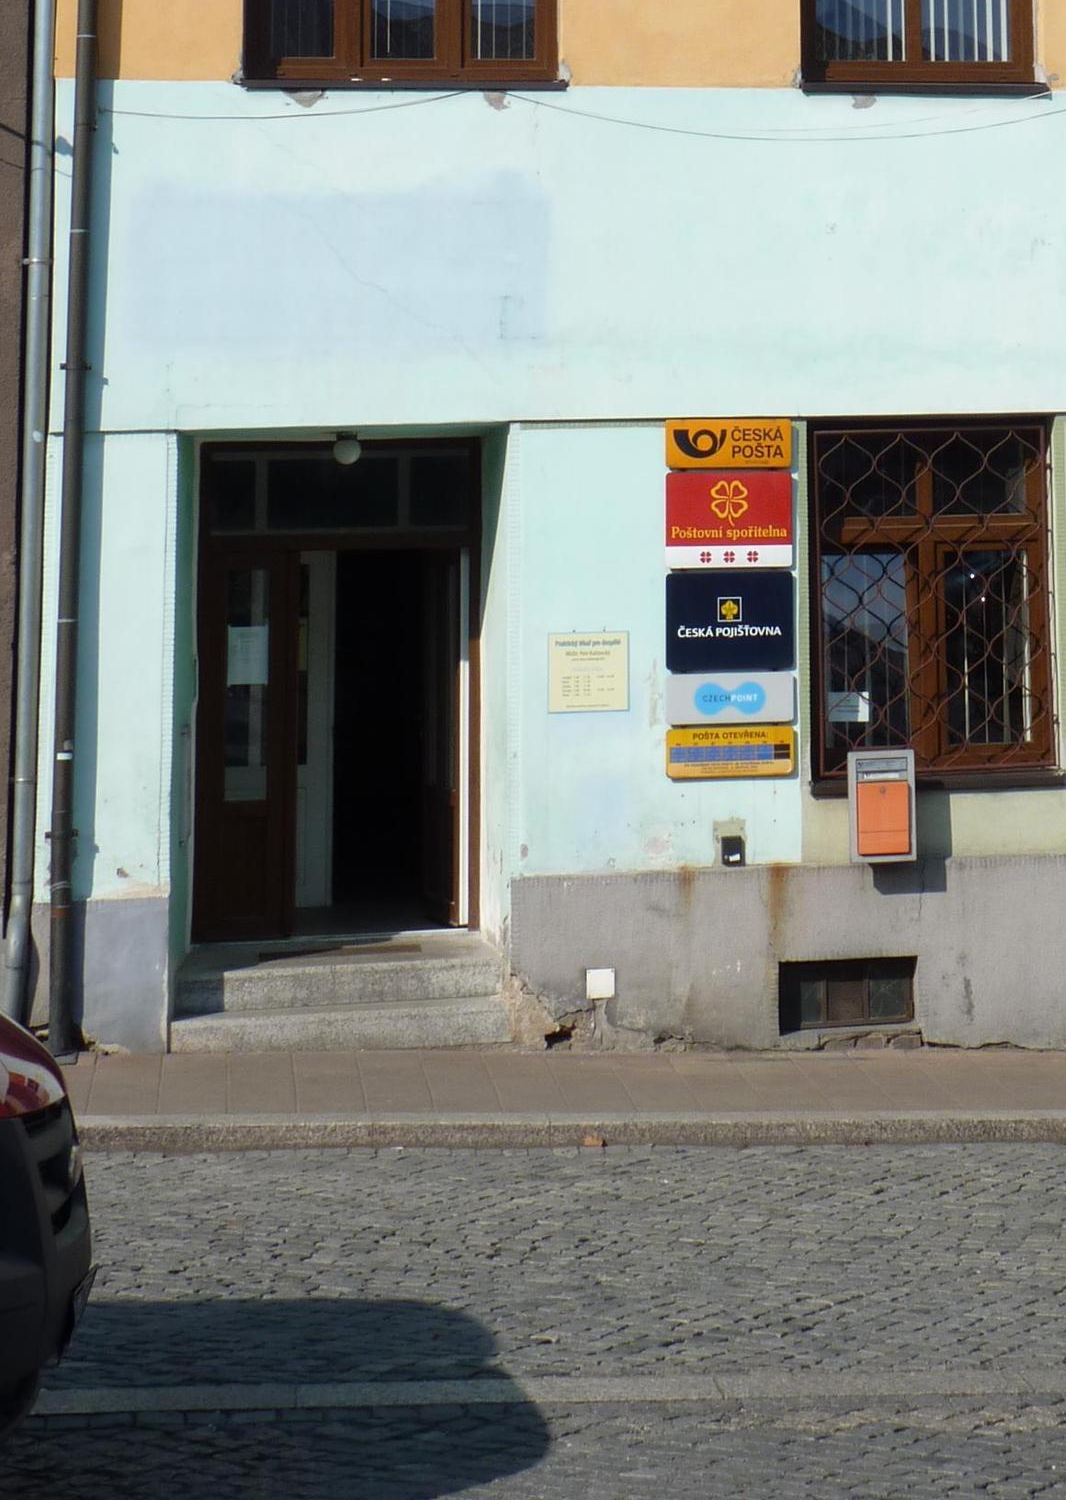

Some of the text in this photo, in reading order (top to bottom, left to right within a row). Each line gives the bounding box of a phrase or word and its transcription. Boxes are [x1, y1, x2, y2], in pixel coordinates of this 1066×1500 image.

[731, 426, 784, 441] ČESKÁ
[731, 443, 784, 458] POŠTA
[671, 525, 787, 540] Poštovní spořitelna
[677, 625, 782, 638] ČESKÁ POJIŠŤOVNA
[692, 731, 720, 740] POŠTA
